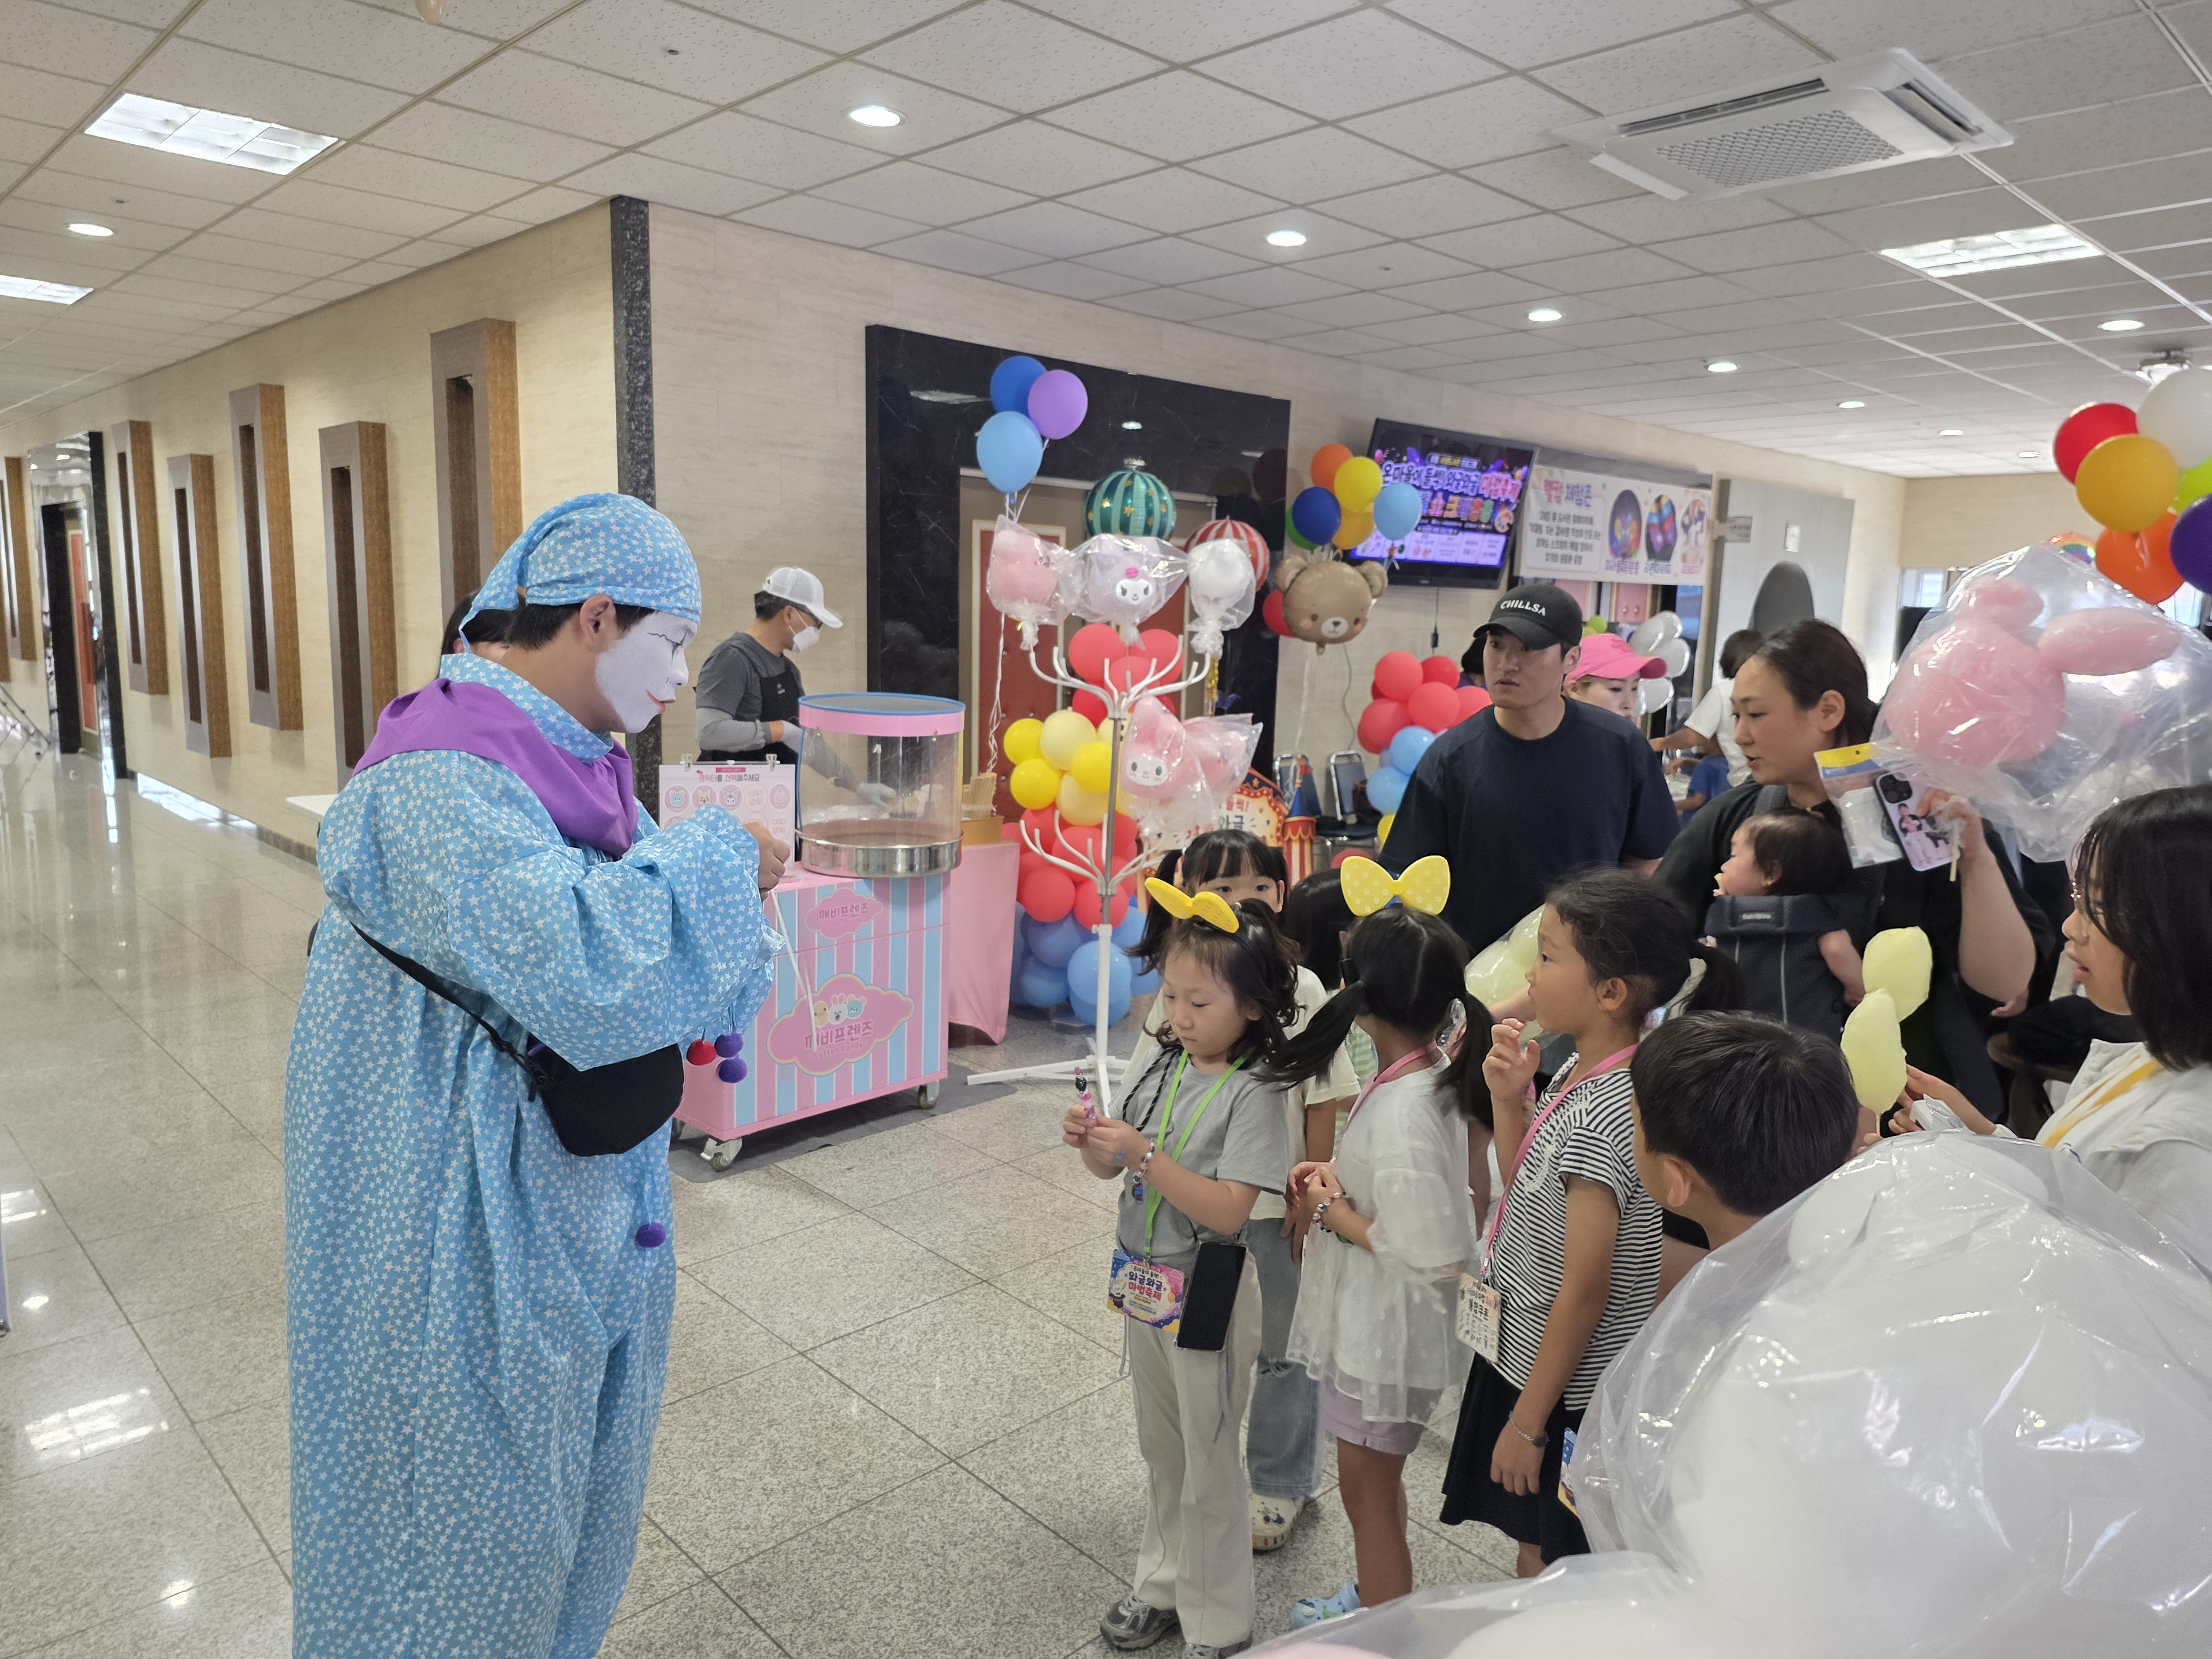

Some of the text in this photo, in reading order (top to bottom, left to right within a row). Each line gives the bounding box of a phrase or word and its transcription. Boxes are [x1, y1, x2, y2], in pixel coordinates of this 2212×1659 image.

[1500, 599, 1546, 616] CHILLSA
[819, 902, 868, 920] 깨비프렌즈
[1134, 1265, 1149, 1275] 온마을이
[1129, 1271, 1163, 1291] 와글와글
[1129, 1281, 1162, 1301] 마법축제
